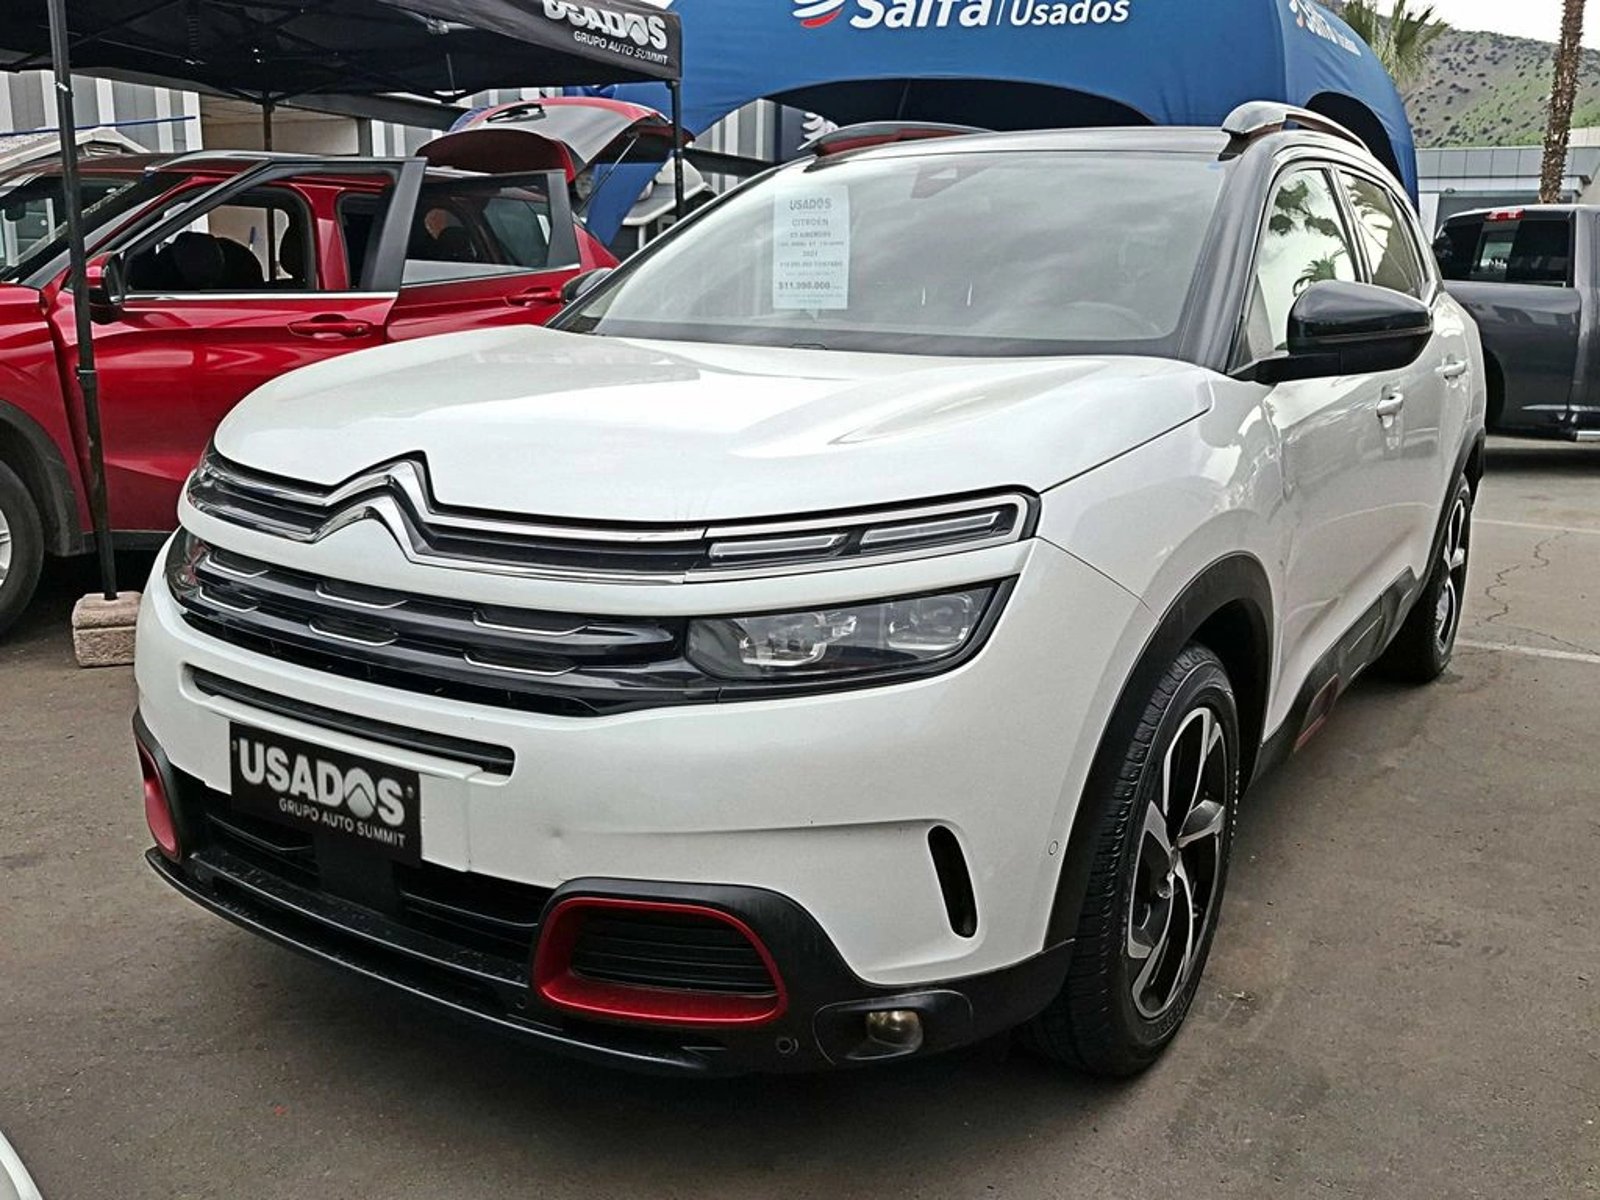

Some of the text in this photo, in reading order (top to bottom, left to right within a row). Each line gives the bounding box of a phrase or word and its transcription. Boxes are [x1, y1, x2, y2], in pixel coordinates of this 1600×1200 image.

[543, 0, 667, 50] USADOS
[1010, 0, 1130, 26] Usados
[573, 30, 669, 65] GRUPO AUTO SUMMIT
[790, 198, 832, 211] USADOS
[239, 738, 405, 826] USADOS
[278, 797, 406, 848] GRUPO AUTO SUMMIT
